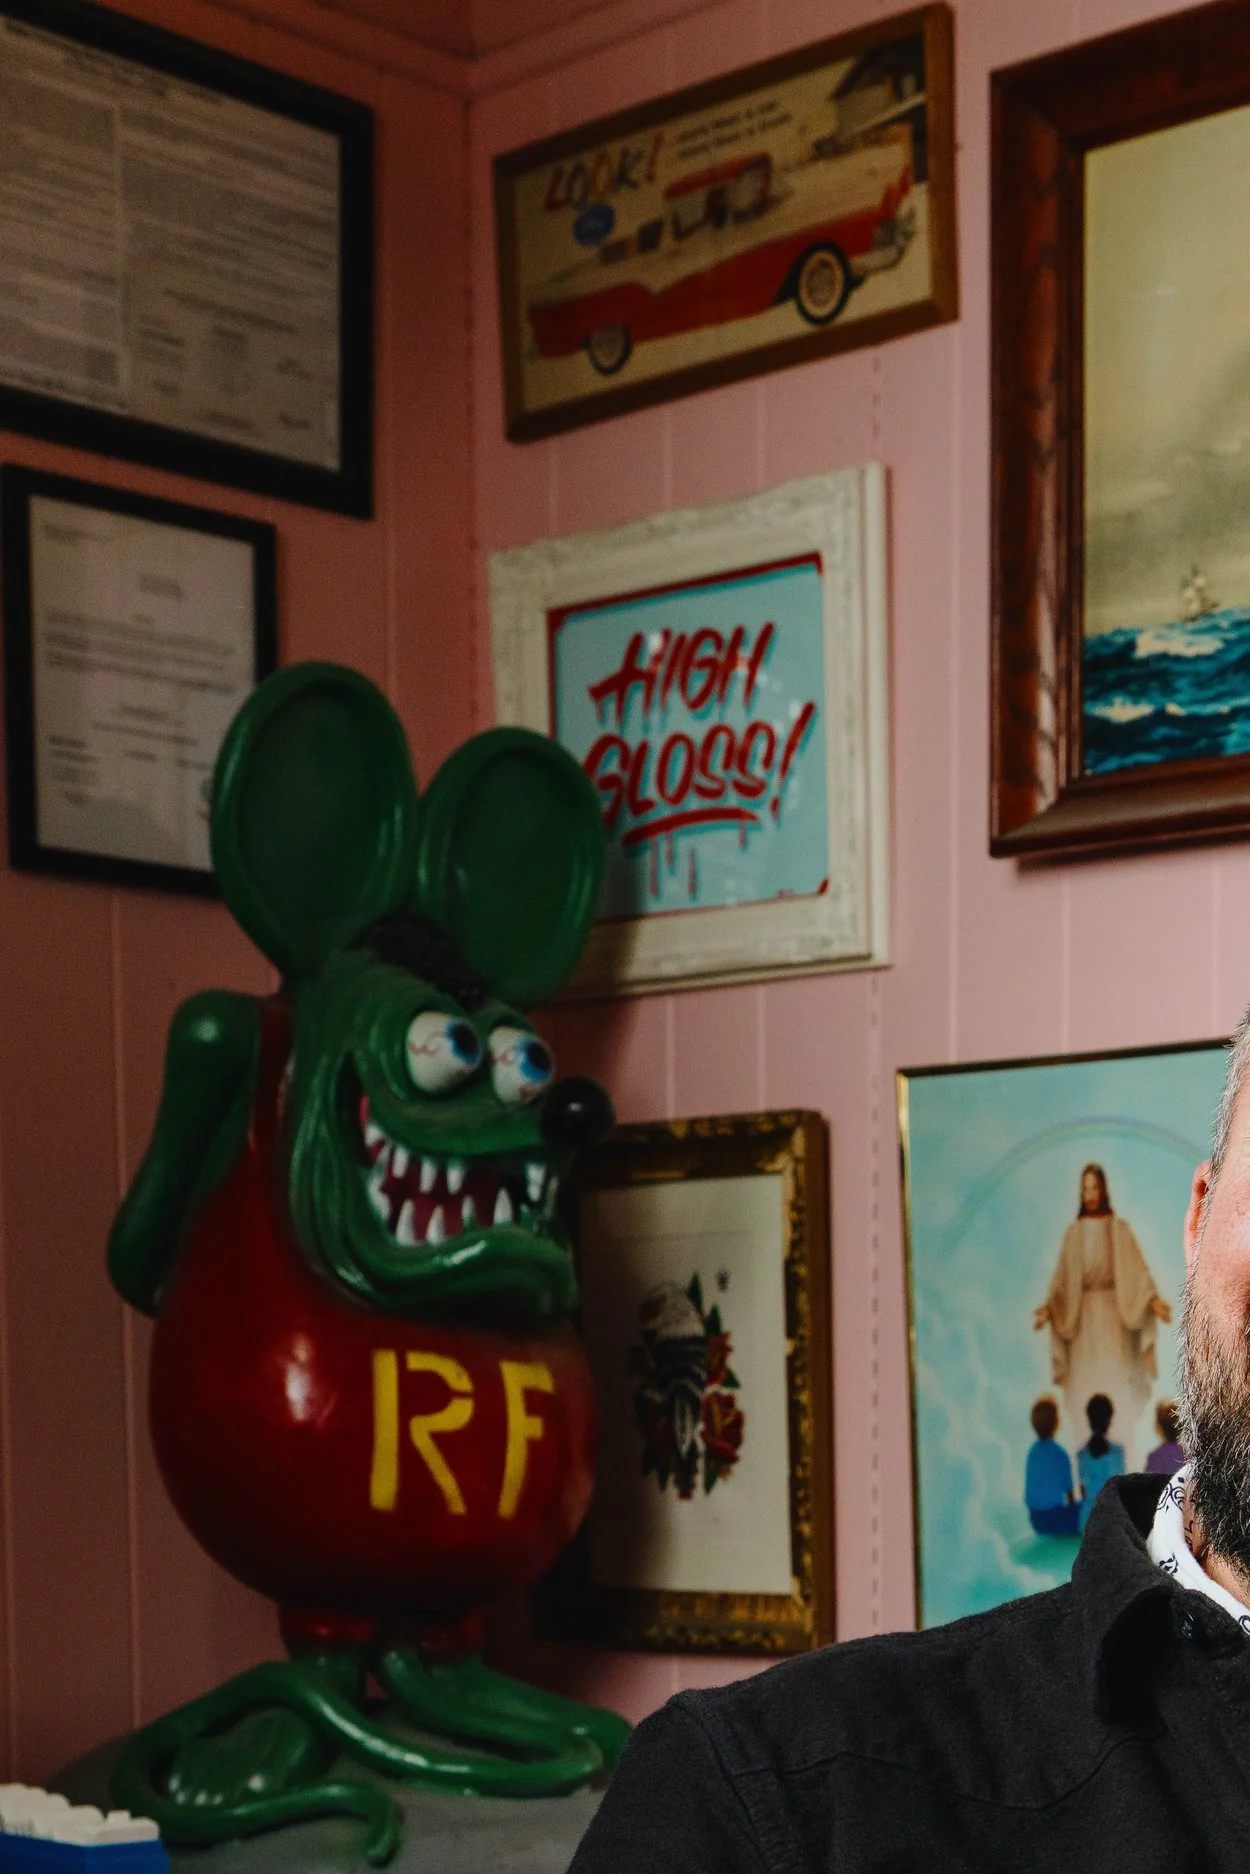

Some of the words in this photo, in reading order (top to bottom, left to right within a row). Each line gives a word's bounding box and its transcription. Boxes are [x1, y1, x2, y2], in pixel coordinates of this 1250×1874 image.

[587, 620, 776, 724] HIGH
[582, 700, 816, 832] GLOSS!
[369, 1349, 555, 1519] RF
